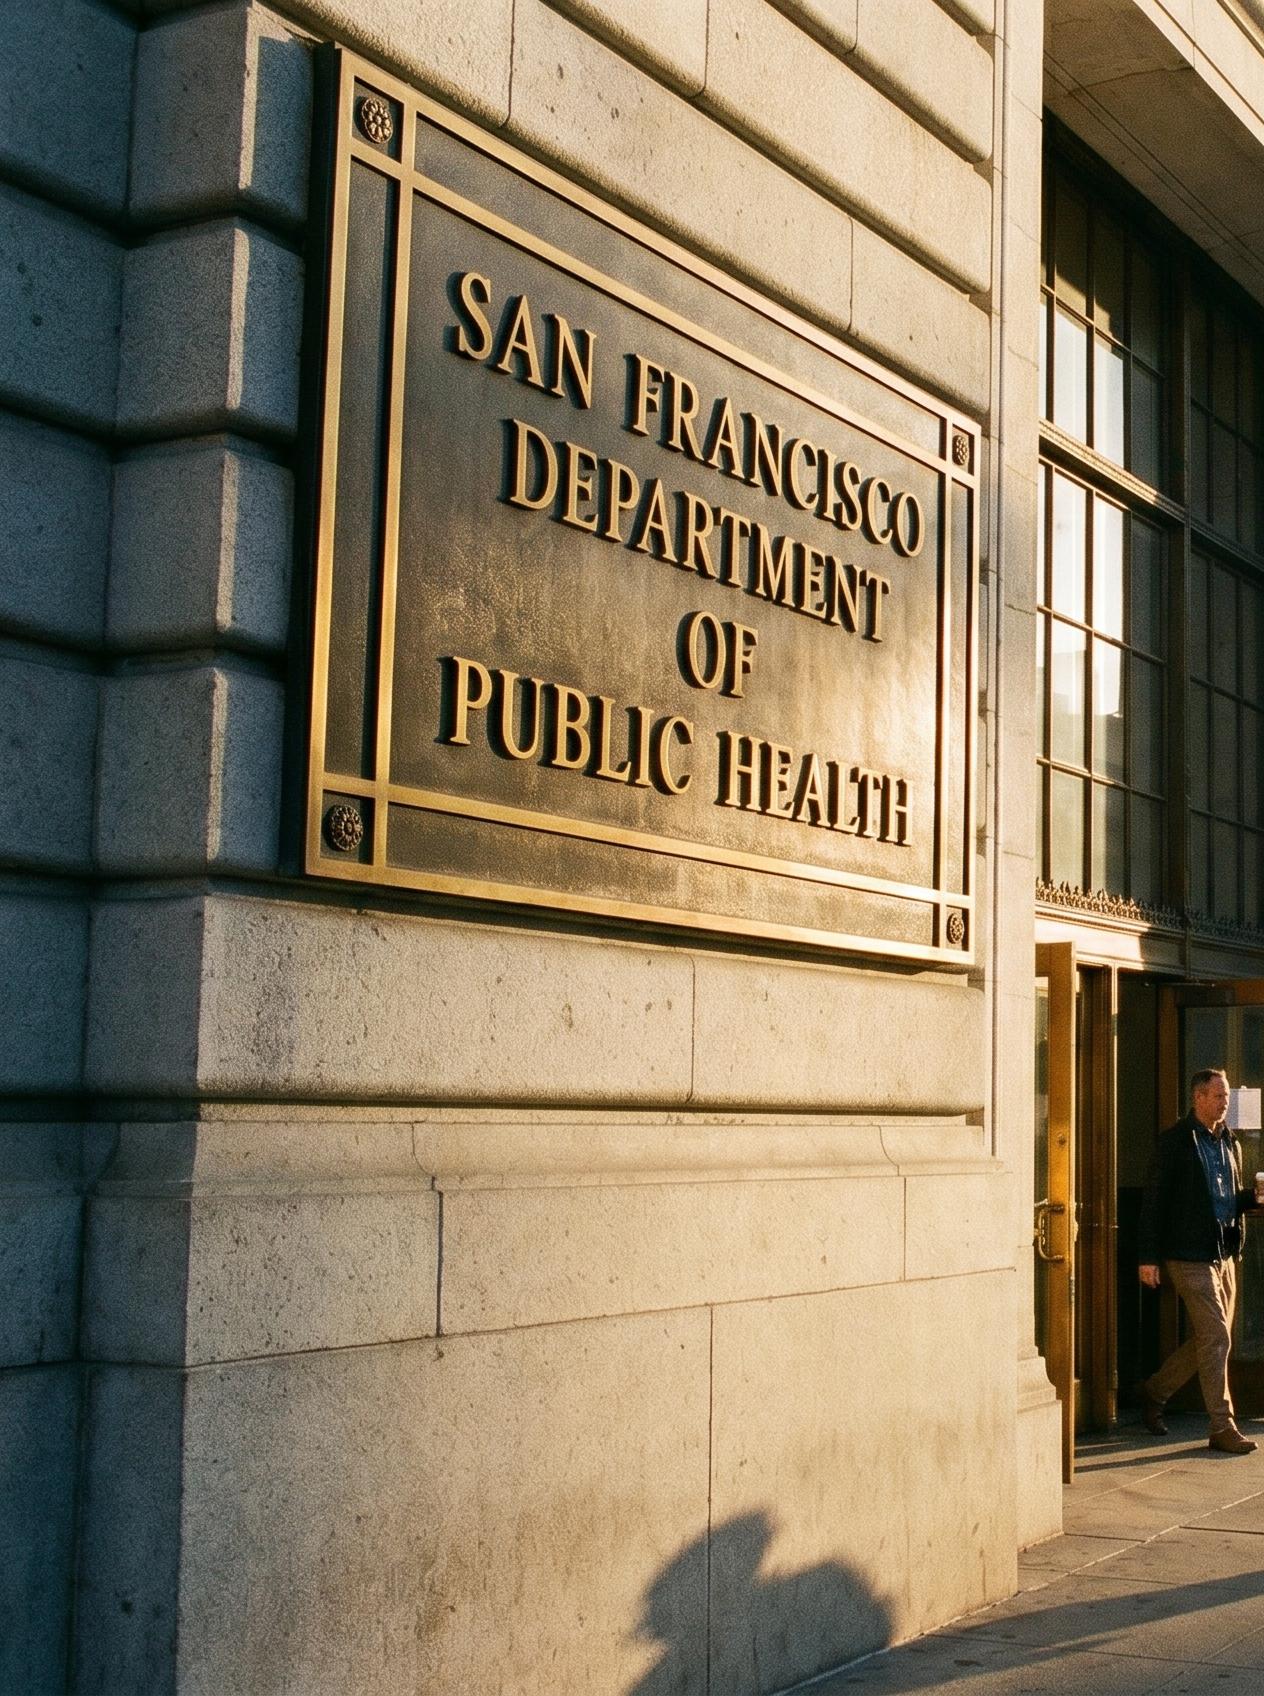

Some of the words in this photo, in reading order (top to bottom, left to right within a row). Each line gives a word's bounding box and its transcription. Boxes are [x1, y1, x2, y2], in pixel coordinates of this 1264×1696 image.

[453, 271, 598, 410] SAN
[630, 352, 926, 557] FRANCISCO
[507, 418, 891, 642] DEPARTMENT
[447, 655, 694, 796] PUBLIC
[721, 729, 914, 847] HEALTH
[685, 610, 759, 698] OF
